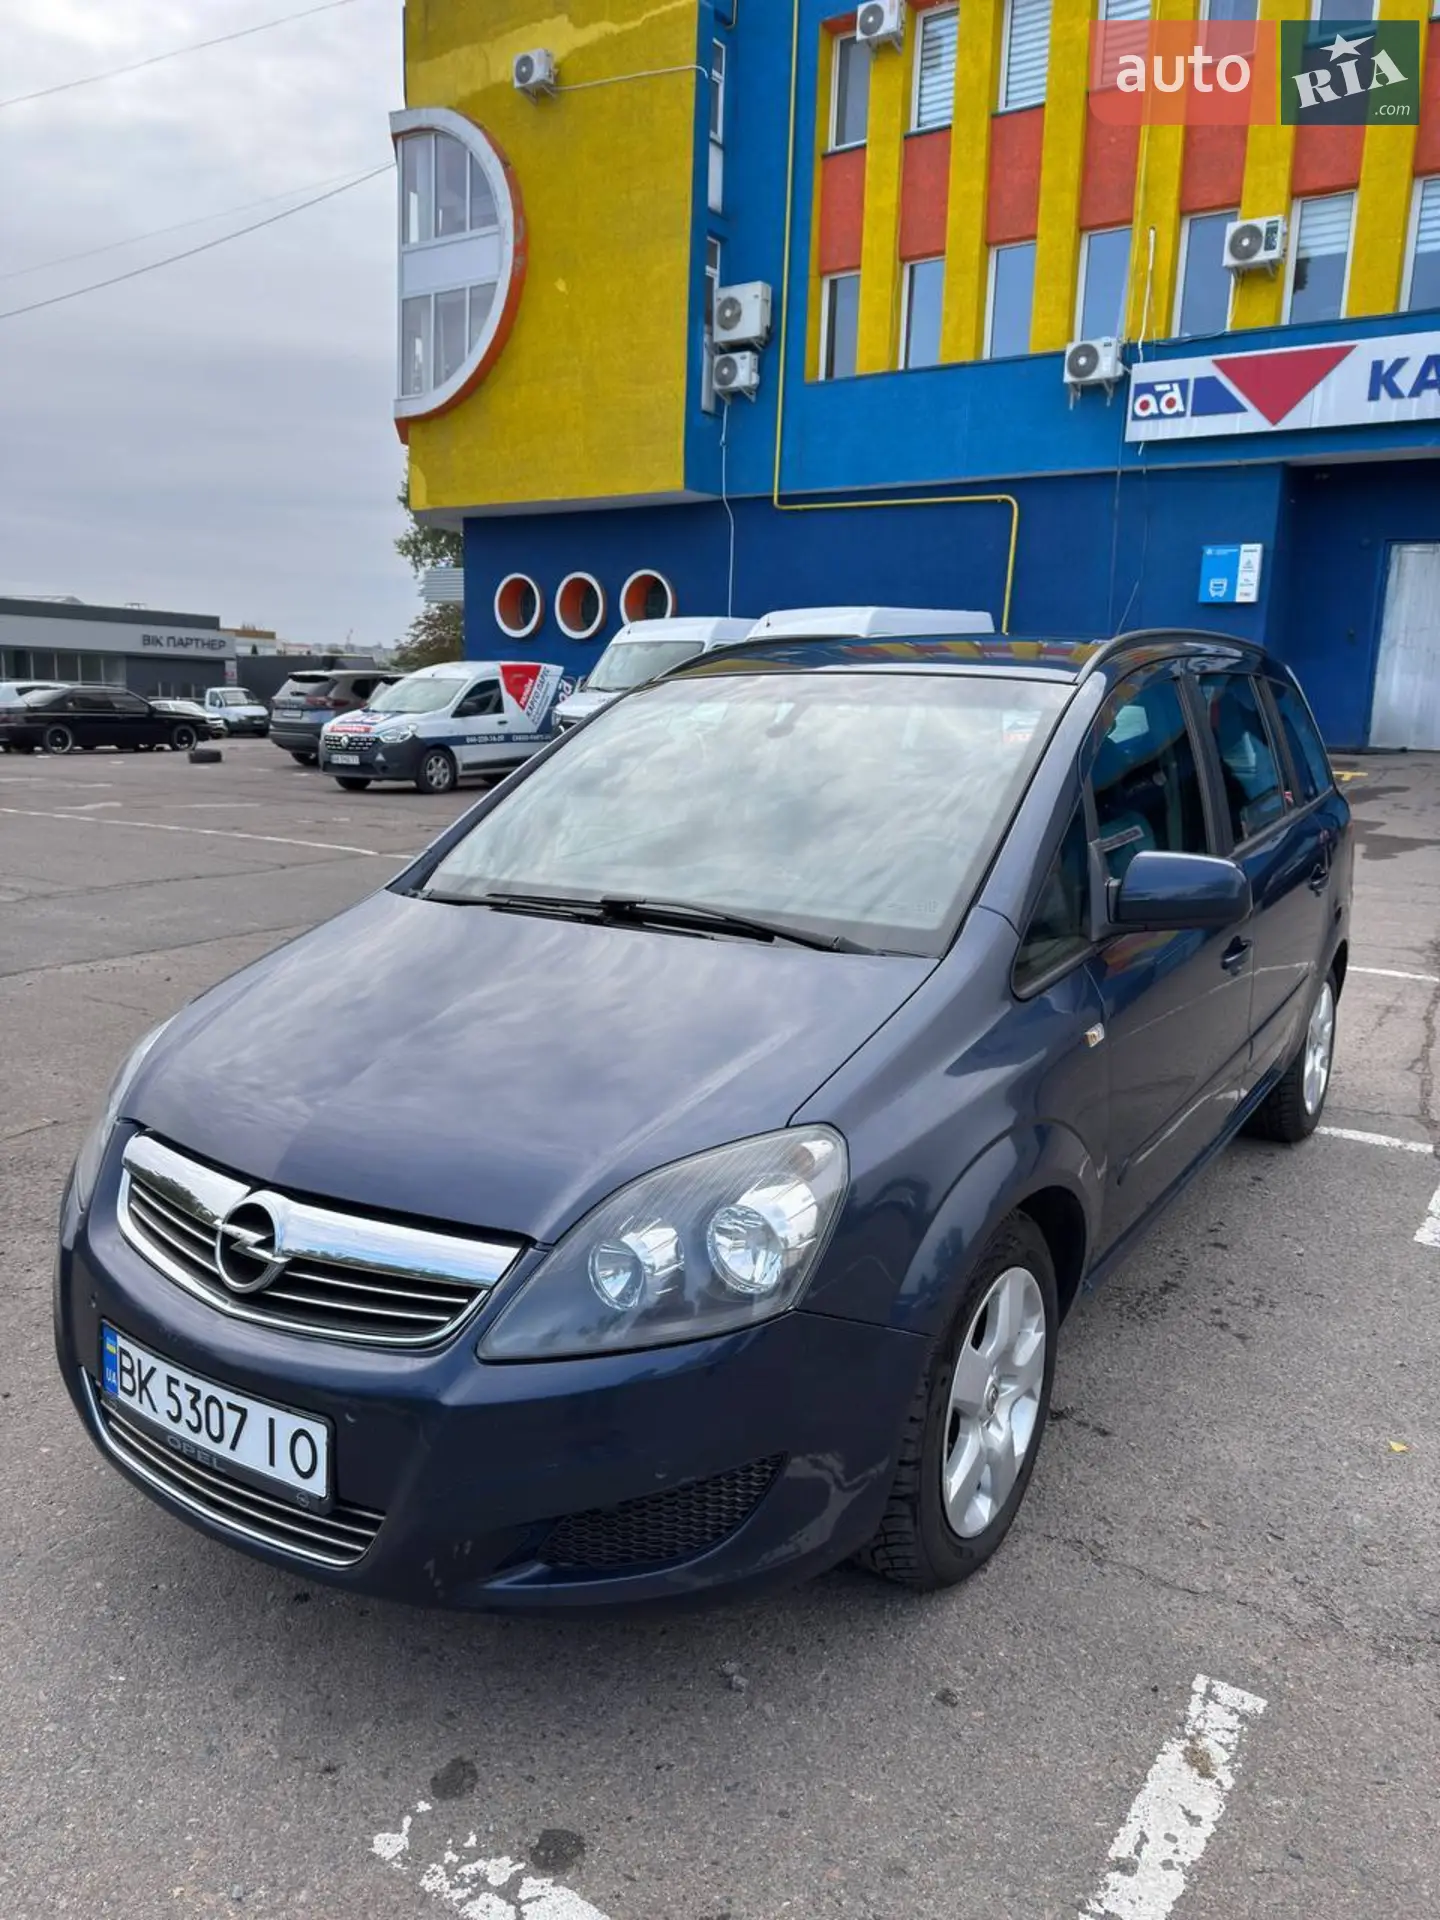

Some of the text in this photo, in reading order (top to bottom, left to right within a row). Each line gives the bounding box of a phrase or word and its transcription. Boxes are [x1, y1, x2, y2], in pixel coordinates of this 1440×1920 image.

[166, 635, 226, 650] ПАРТНЕР
[106, 1367, 117, 1383] UA
[119, 1347, 318, 1480] BK 5307 IO
[167, 1435, 227, 1473] OPEL
